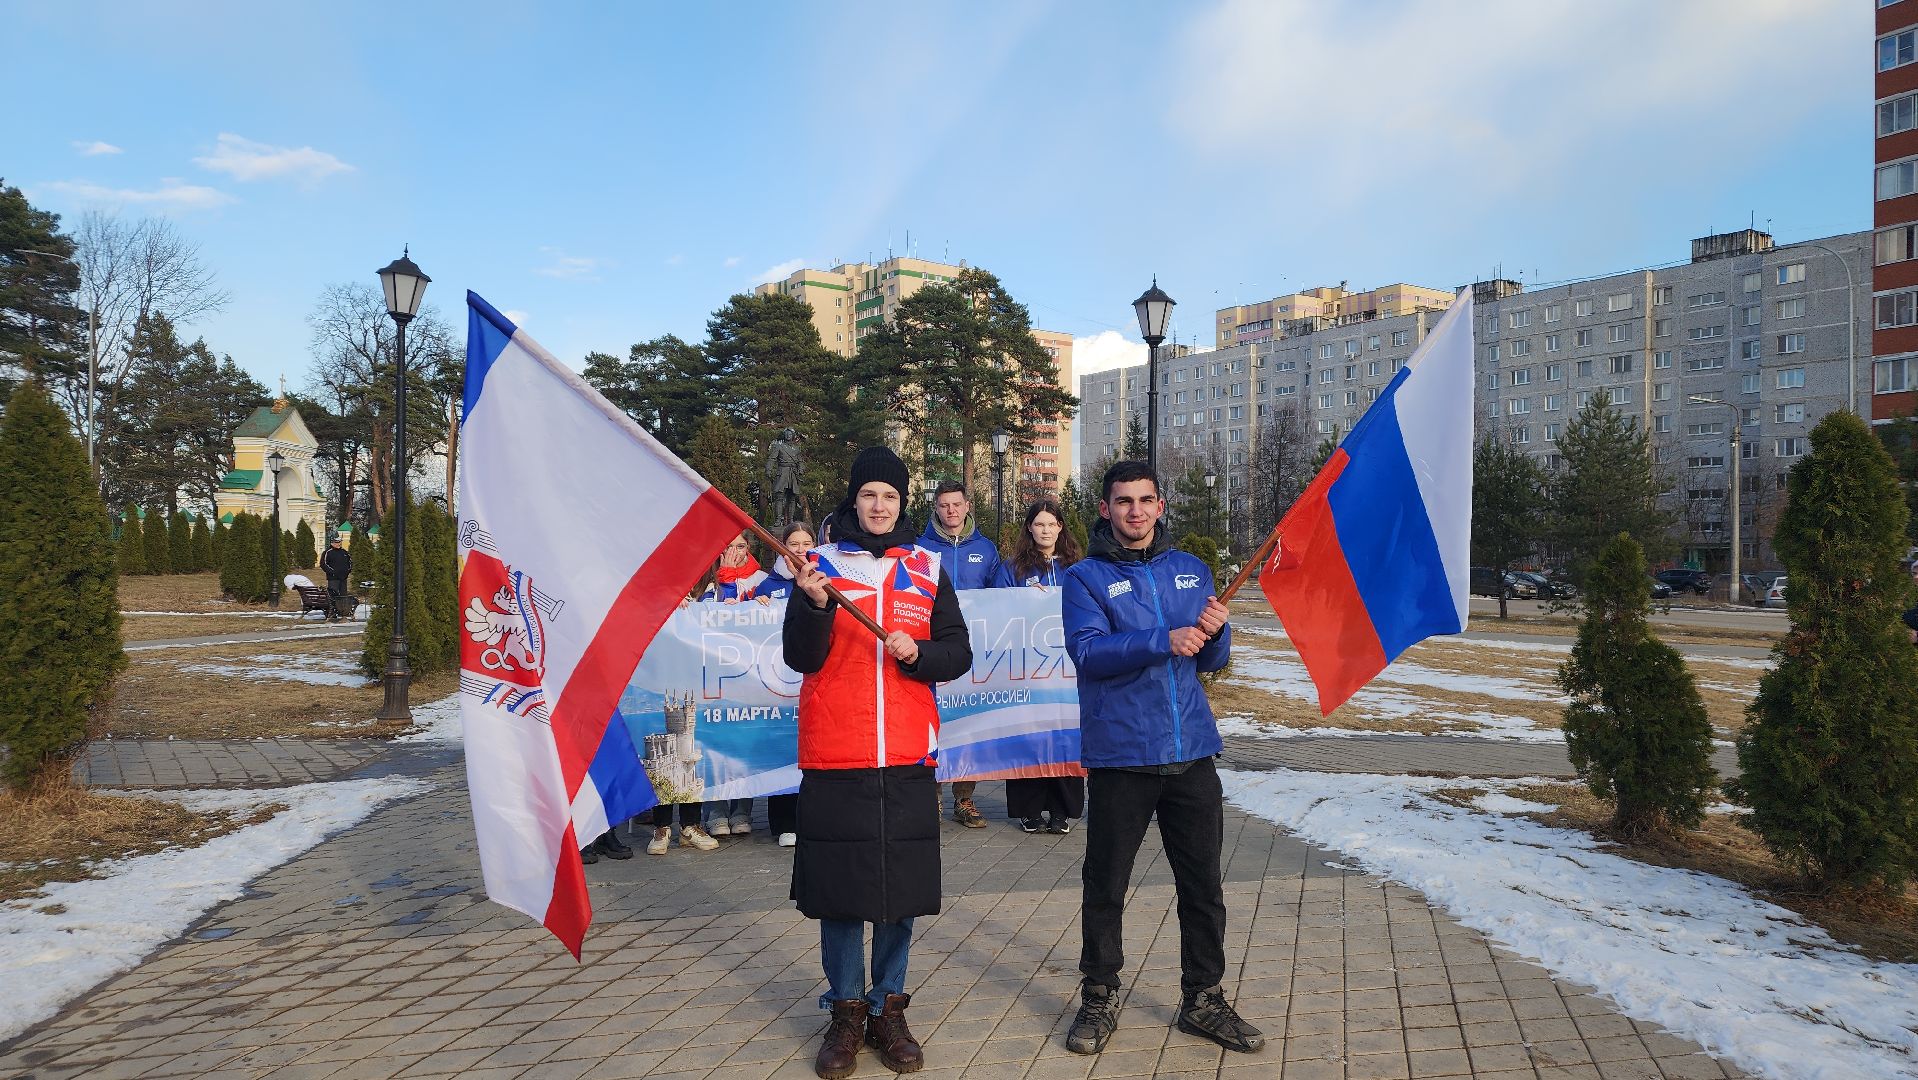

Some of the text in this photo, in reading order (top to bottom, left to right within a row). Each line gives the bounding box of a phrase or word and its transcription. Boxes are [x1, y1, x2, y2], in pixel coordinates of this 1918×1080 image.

[700, 608, 778, 627] КРЫМ
[704, 707, 722, 723] 18
[726, 705, 781, 722] МАРТА
[935, 693, 967, 709] РЫМА
[969, 692, 977, 706] С
[980, 686, 1031, 705] РОССИЕЙ
